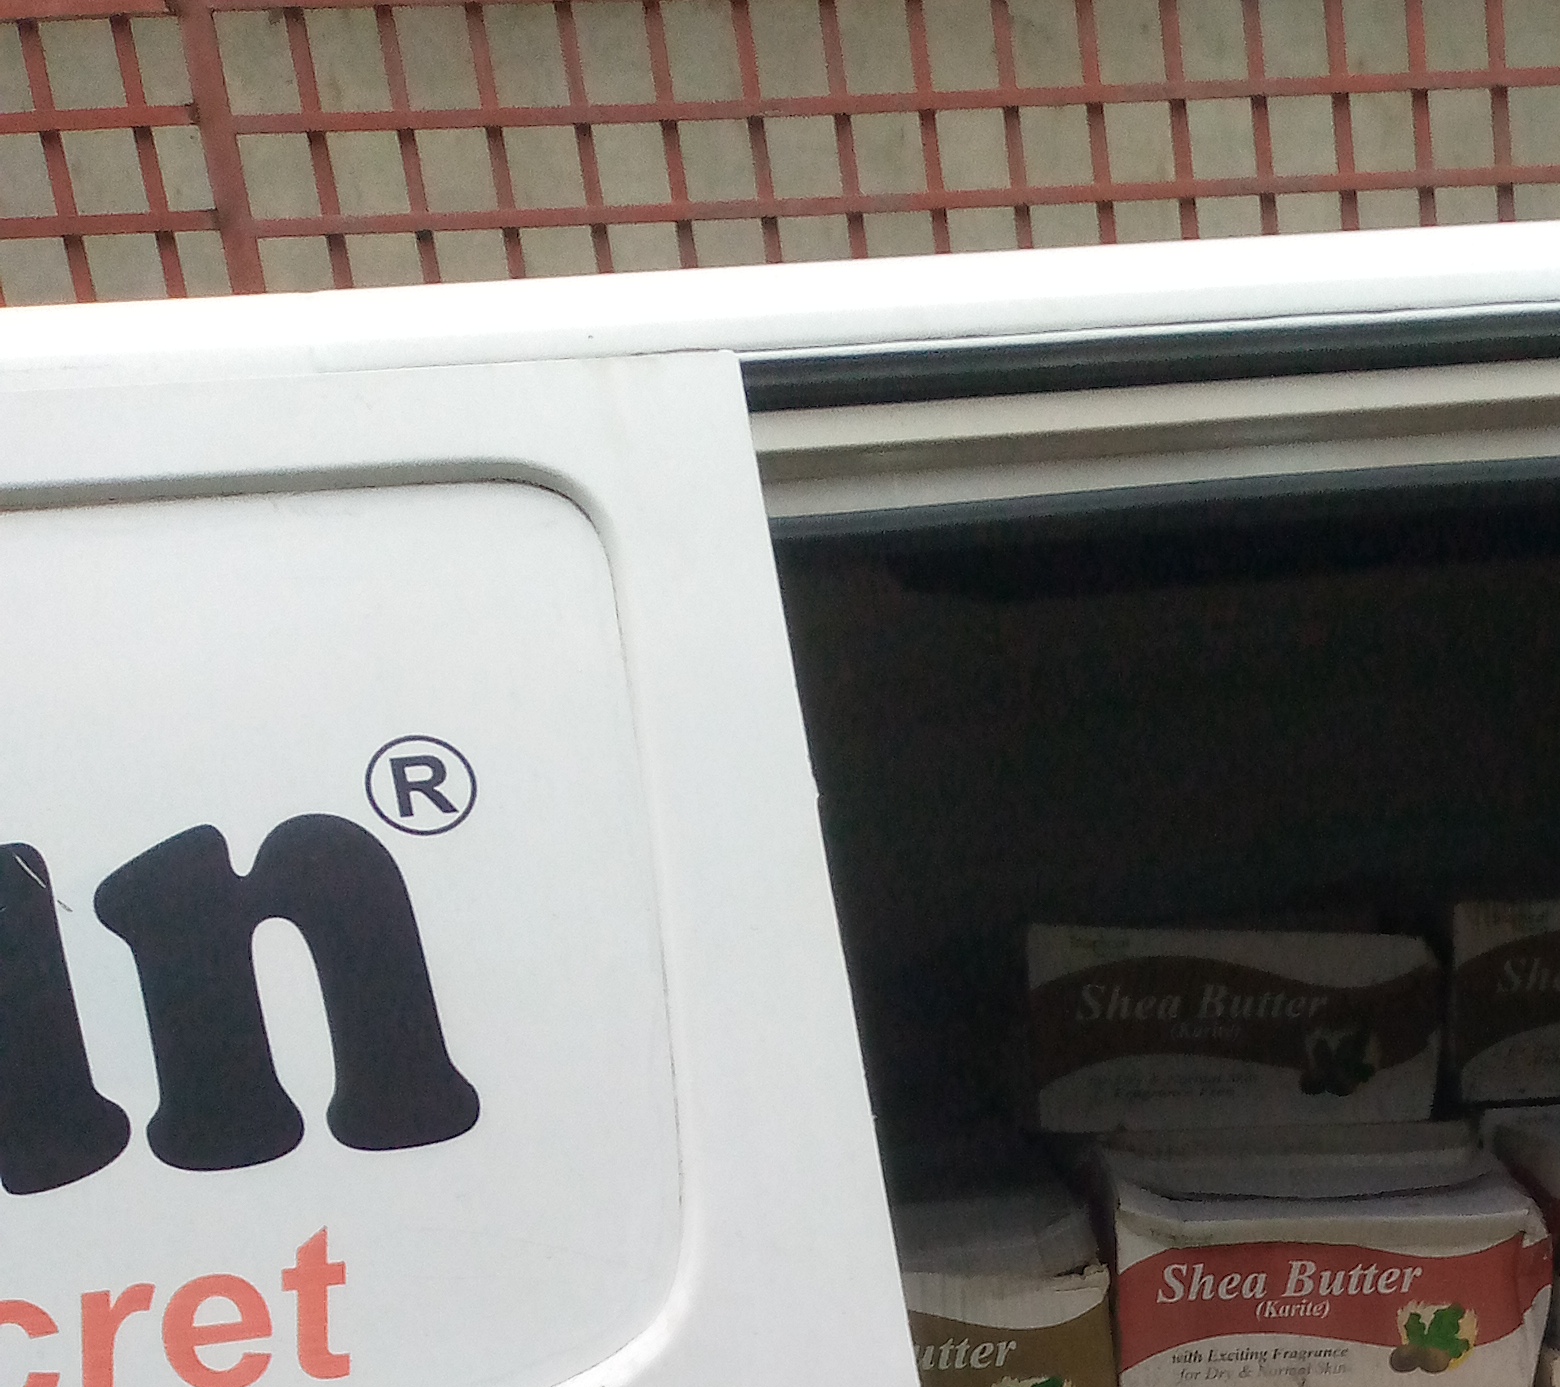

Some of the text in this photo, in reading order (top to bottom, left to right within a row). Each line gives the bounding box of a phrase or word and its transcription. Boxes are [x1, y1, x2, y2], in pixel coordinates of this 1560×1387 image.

[1075, 983, 1329, 1023] Shea Butter
[1157, 1259, 1424, 1305] Shea Butter
[1172, 1346, 1349, 1366] with Exciting Fragrance
